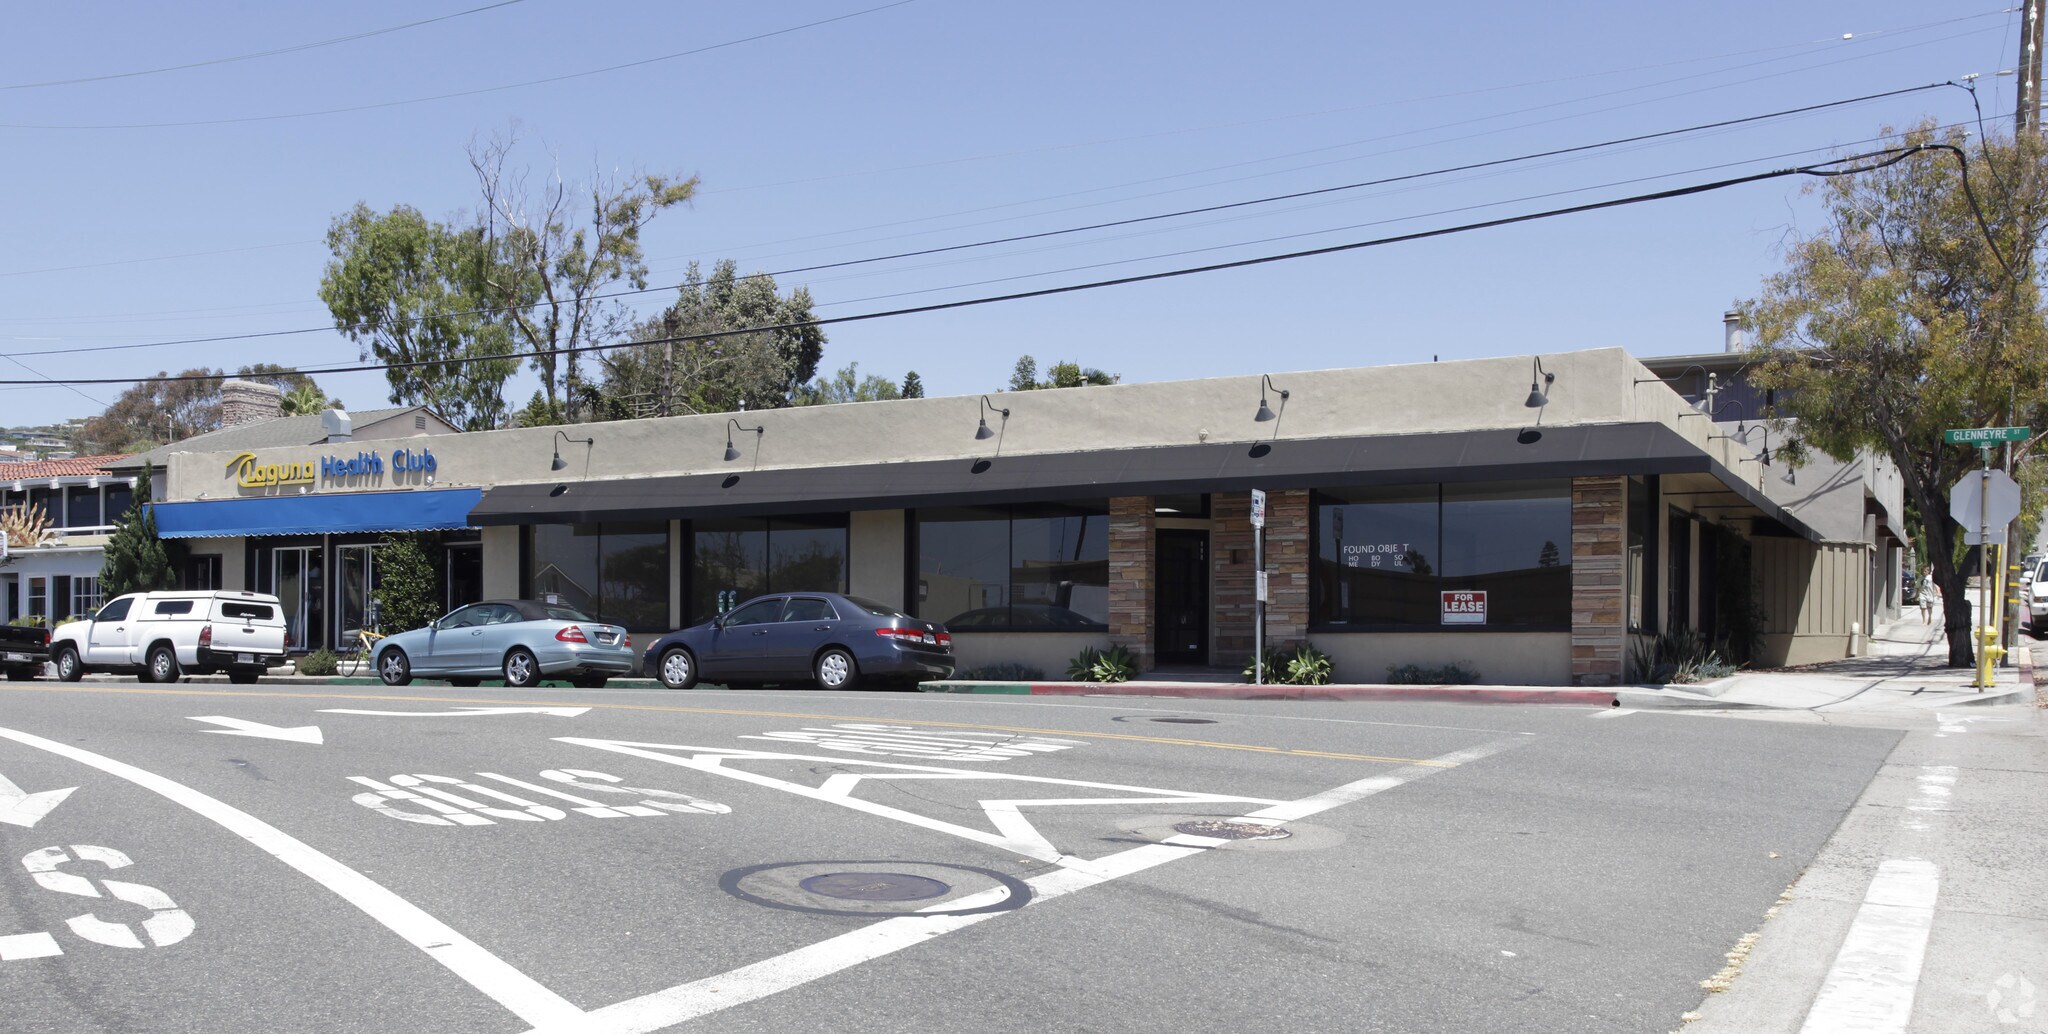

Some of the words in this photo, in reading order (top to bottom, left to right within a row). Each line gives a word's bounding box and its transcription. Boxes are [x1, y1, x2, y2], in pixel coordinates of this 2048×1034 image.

[1953, 429, 2008, 441] GLENNEYRE
[246, 459, 315, 486] Laguna
[321, 450, 384, 477] Health
[392, 447, 437, 473] Club
[1343, 544, 1375, 554] FOUND
[1377, 543, 1409, 554] OBJET
[1454, 593, 1473, 601] FOR
[1444, 601, 1484, 612] LEASE
[344, 768, 733, 827] STOP
